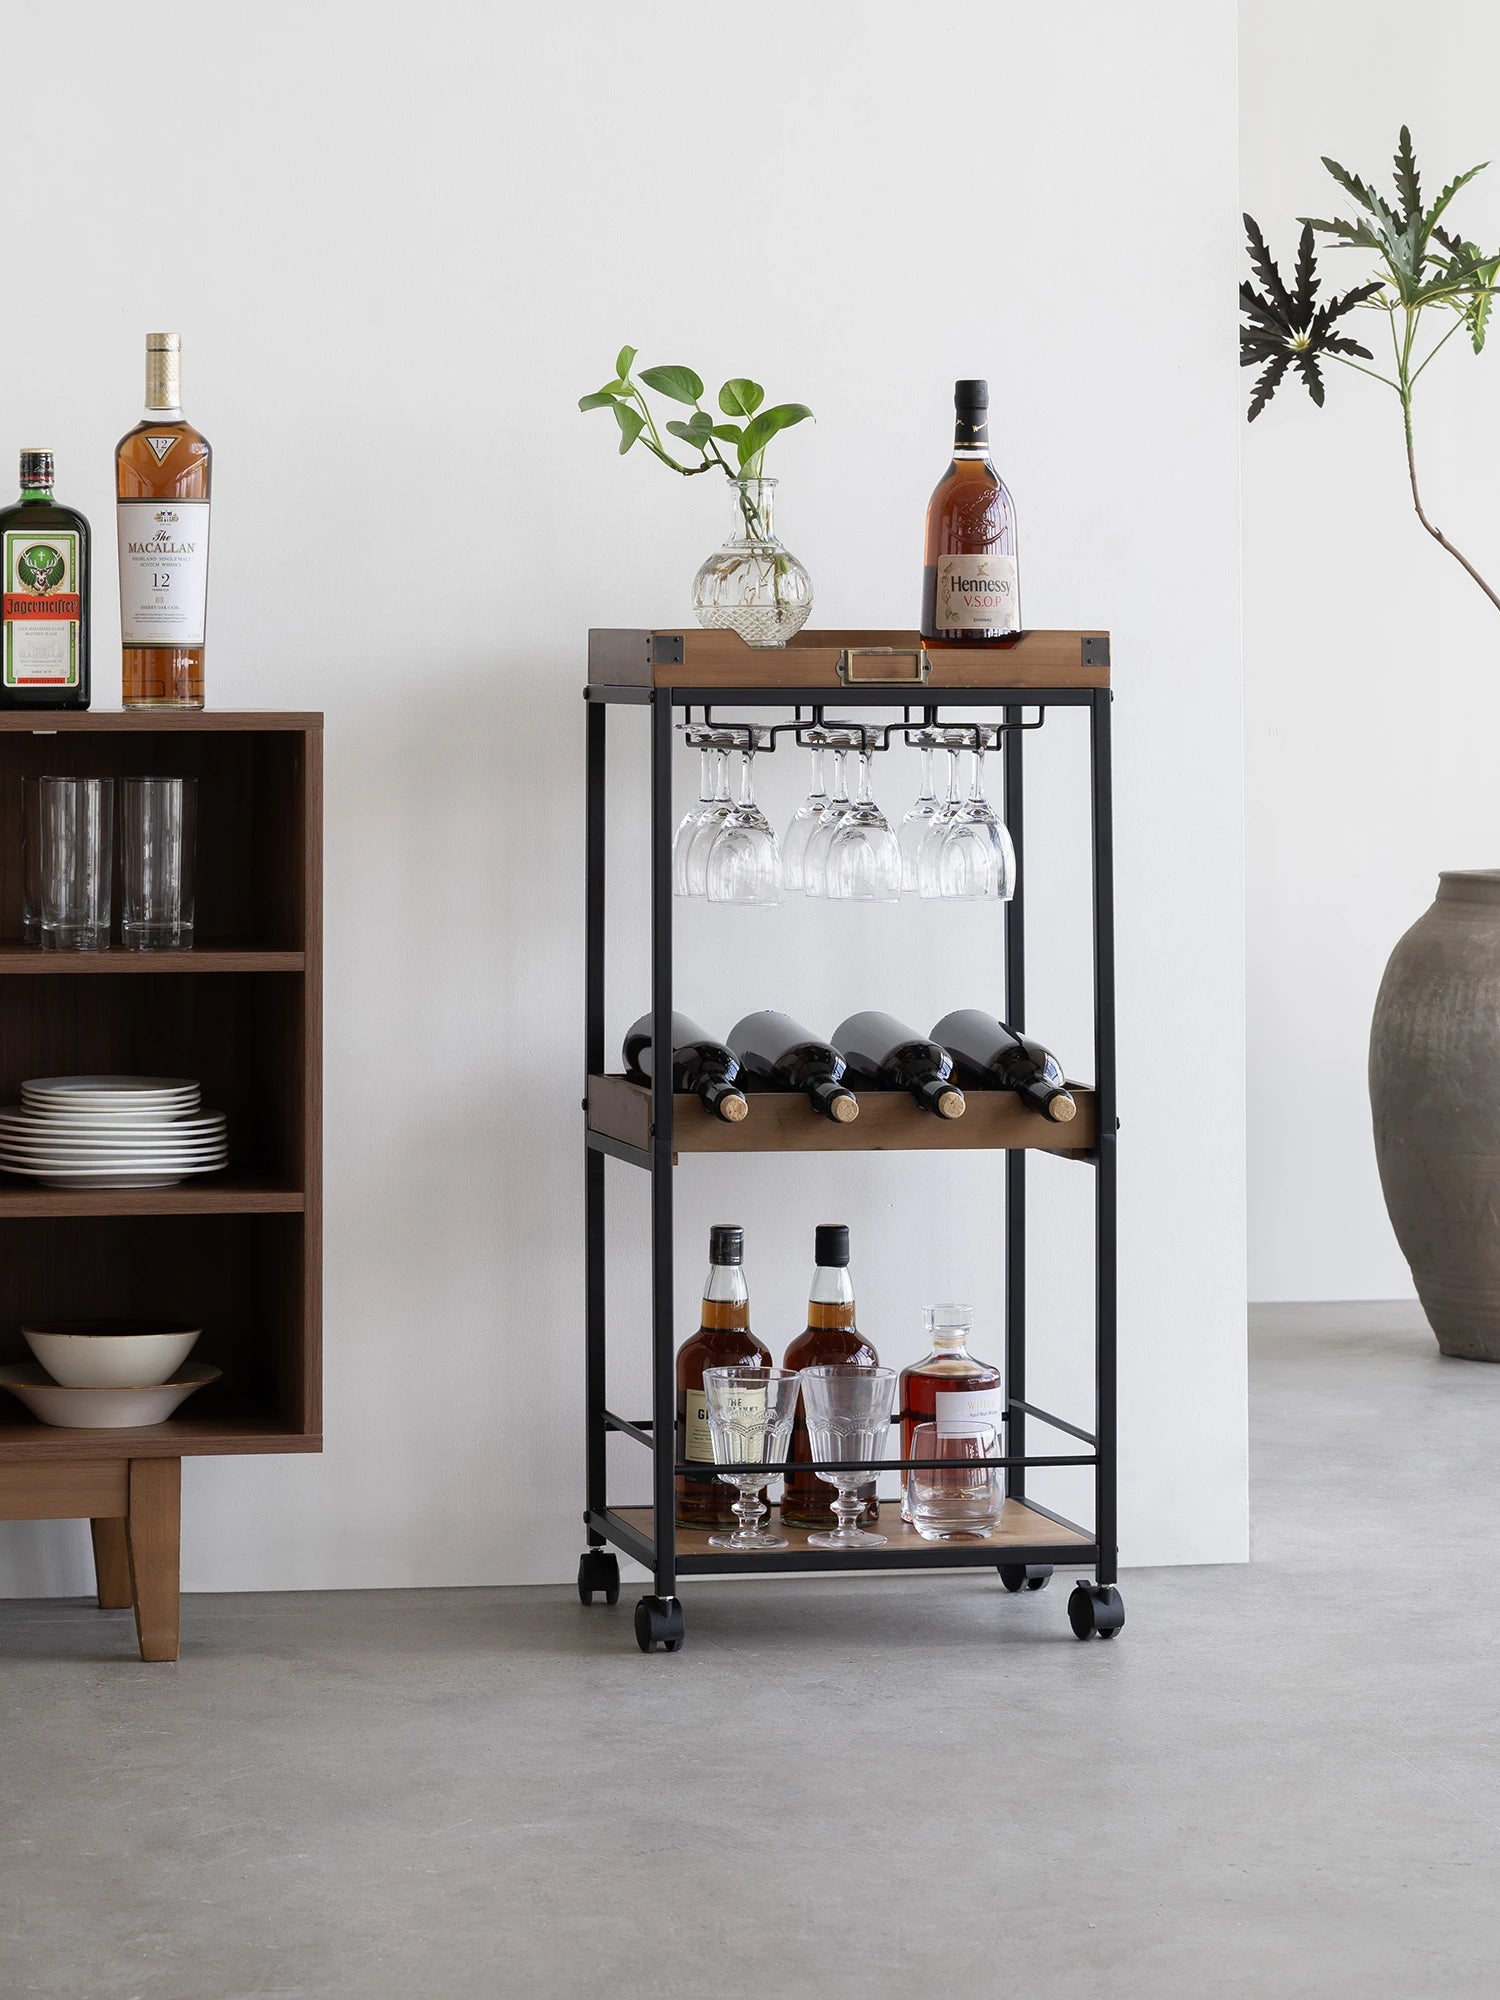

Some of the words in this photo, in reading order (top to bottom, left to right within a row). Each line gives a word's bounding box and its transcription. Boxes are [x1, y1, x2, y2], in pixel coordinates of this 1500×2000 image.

[154, 438, 168, 449] 12
[152, 529, 172, 541] The
[127, 542, 195, 554] MACALLAN
[152, 573, 170, 588] 12
[951, 575, 1010, 596] Hennessy
[963, 595, 1002, 608] V.S.O.P
